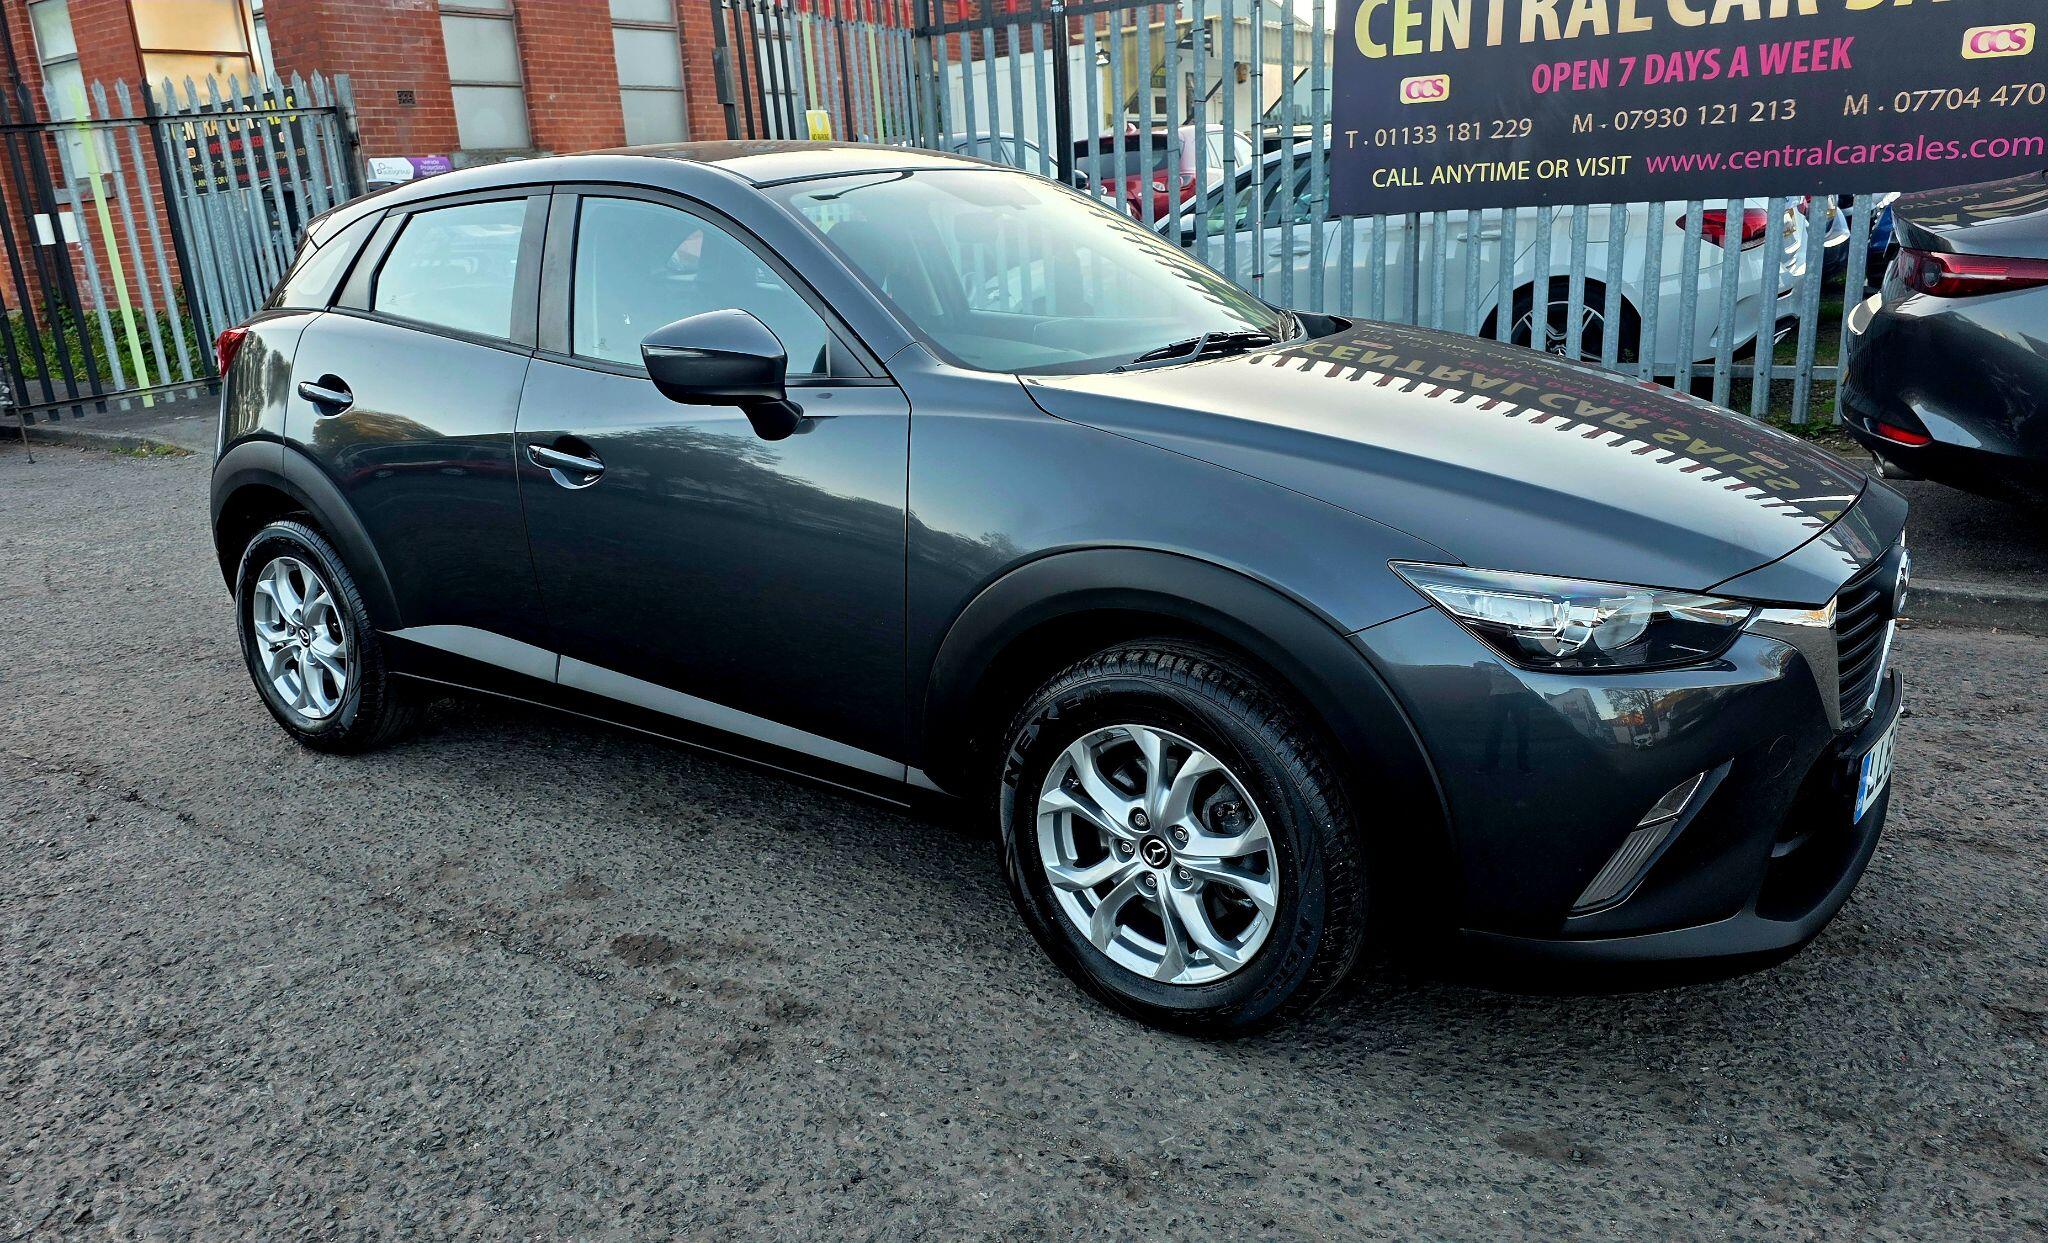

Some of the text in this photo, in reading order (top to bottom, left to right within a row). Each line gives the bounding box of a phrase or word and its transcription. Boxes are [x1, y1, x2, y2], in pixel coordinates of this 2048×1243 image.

[1531, 36, 1855, 94] OPEN 7 DAYS A WEEK
[1614, 106, 1688, 131] 07930
[1698, 102, 1737, 126] 121
[1749, 98, 1797, 122] 213
[1894, 87, 1981, 114] 07704
[1990, 82, 2046, 107] 470
[1375, 125, 1437, 148] 01133
[1447, 122, 1481, 143] 181
[1490, 117, 1533, 140] 229
[1372, 134, 2045, 188] CALL ANYTIME OR VISIT www.centralcarsales.com
